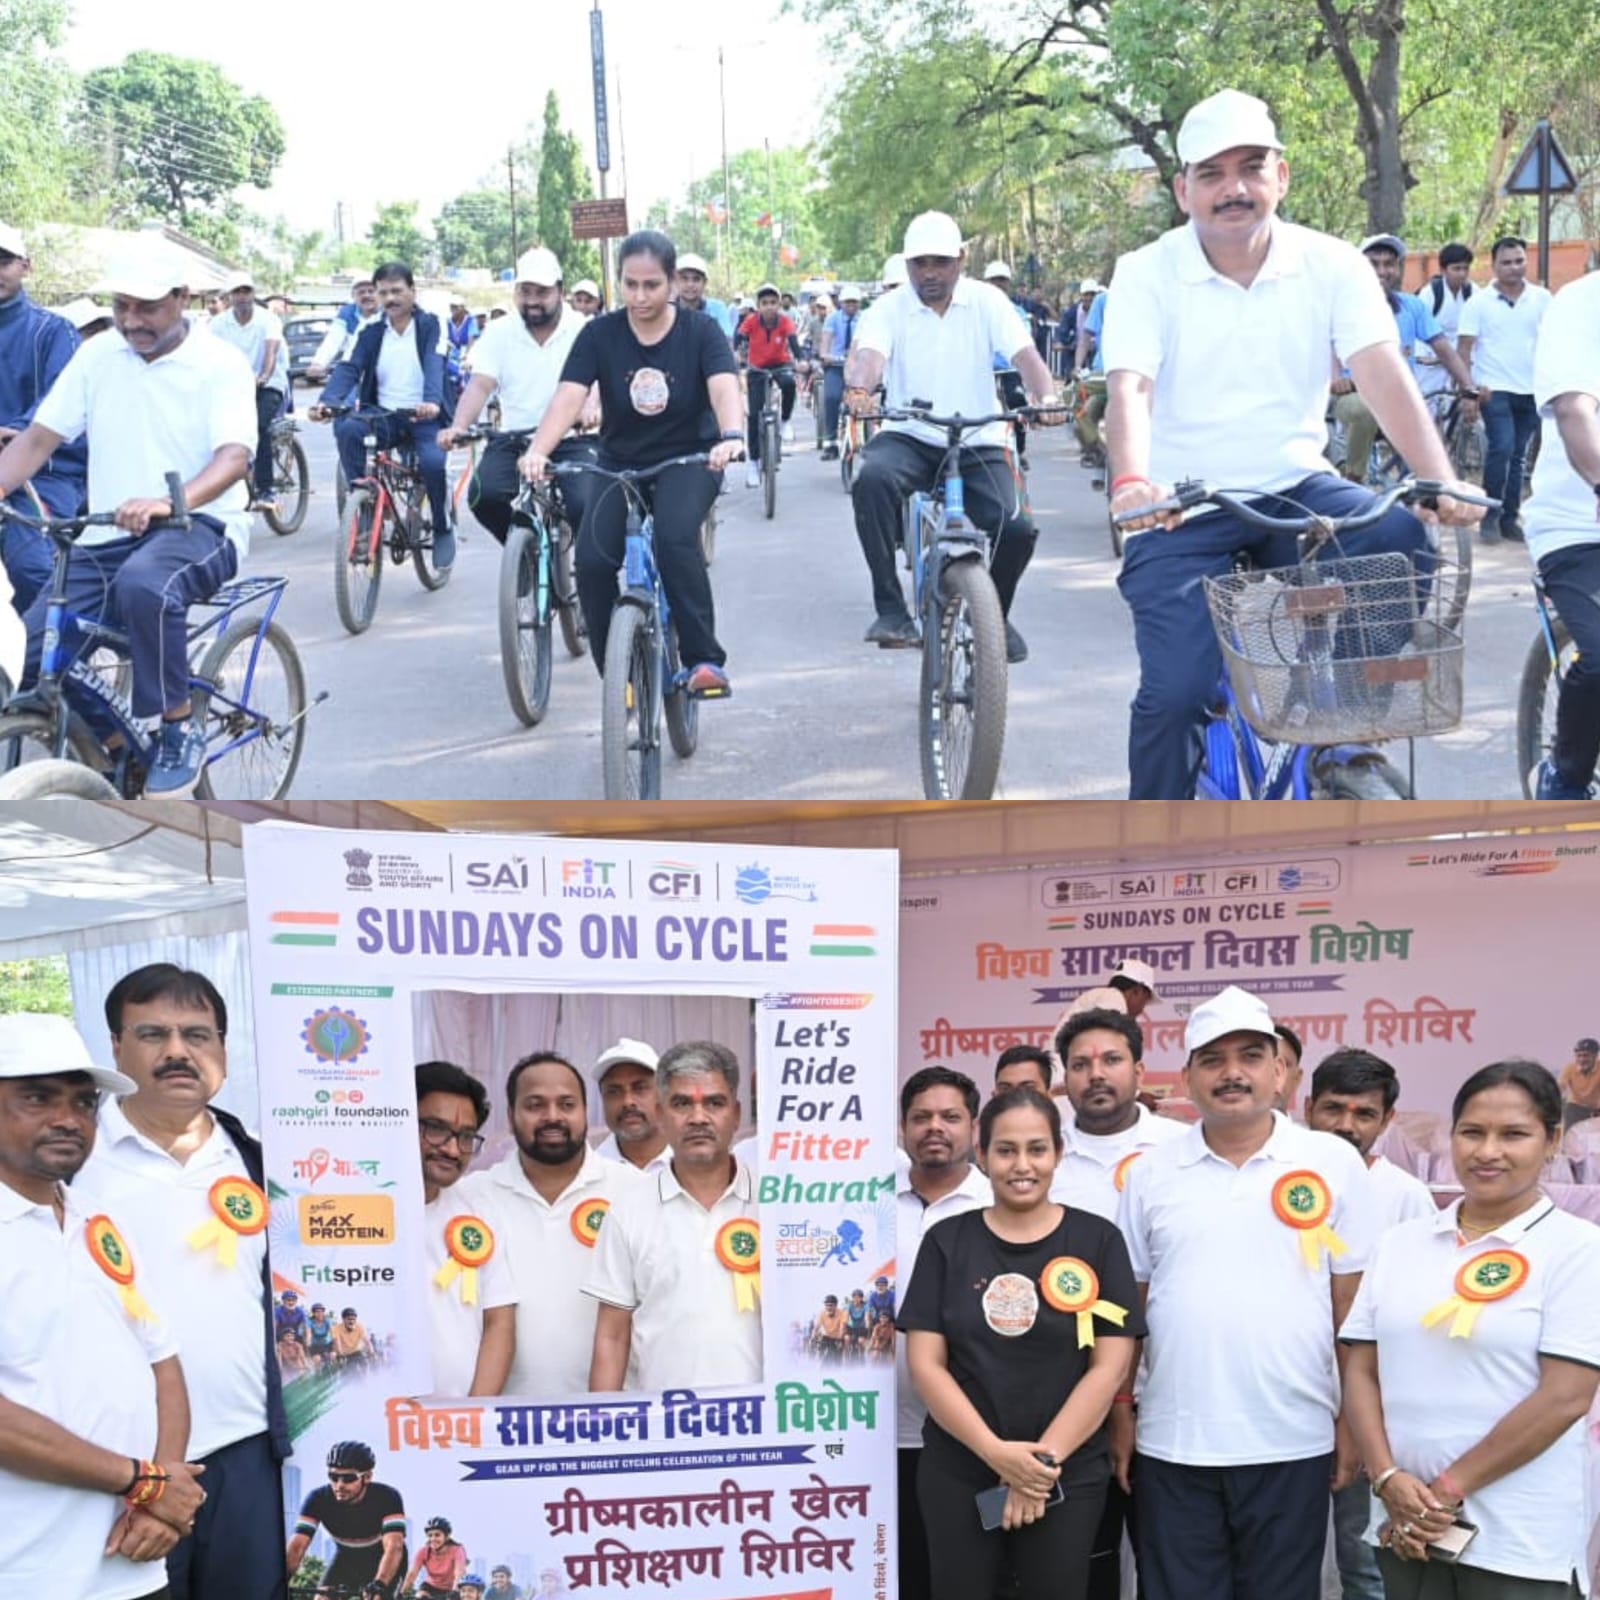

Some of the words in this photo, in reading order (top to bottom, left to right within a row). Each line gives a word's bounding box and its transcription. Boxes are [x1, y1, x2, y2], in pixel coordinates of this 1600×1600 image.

[1460, 852, 1485, 863] Ride
[1488, 851, 1509, 861] For
[1510, 850, 1518, 860] A
[1555, 846, 1597, 857] Bharat
[400, 881, 432, 889] SPORTS
[562, 885, 616, 899] INDIA
[648, 872, 701, 896] CFI
[1173, 888, 1205, 897] INDIA
[1224, 876, 1257, 890] CFI
[1083, 906, 1175, 930] SUNDAYS
[1183, 906, 1212, 925] ON
[1219, 902, 1286, 922] CYCLE
[357, 907, 563, 958] SUNDAYS
[580, 914, 638, 959] ON
[656, 915, 788, 962] CYCLE
[976, 943, 1053, 981] विश्व
[1061, 940, 1195, 976] सायकल
[1204, 930, 1300, 970] दिवस
[1310, 921, 1413, 965] विशेष
[775, 1019, 850, 1047] Let's
[1364, 996, 1476, 1047] शिविर
[781, 1056, 856, 1085] Ride
[272, 1105, 328, 1120] raahgiri
[335, 1106, 410, 1118] foundation
[777, 1094, 834, 1122] For
[839, 1094, 862, 1121] A
[769, 1130, 870, 1161] Fitter
[758, 1174, 880, 1204] Bharat
[309, 1213, 354, 1227] MAX
[310, 1227, 384, 1239] PROTEIN
[302, 1264, 394, 1286] Fitspire
[385, 1396, 484, 1451] विश्व
[495, 1400, 652, 1446] सायकल
[661, 1388, 765, 1439] दिवस
[775, 1379, 879, 1434] विशेष
[825, 1438, 844, 1459] एवं
[495, 1463, 520, 1474] GEAR
[523, 1463, 536, 1473] UP
[539, 1462, 558, 1473] FOR
[560, 1460, 578, 1471] THE
[581, 1459, 619, 1470] BIGGEST
[621, 1457, 661, 1468] CYCLING
[663, 1454, 724, 1466] CELEBRATION
[726, 1453, 738, 1463] OF
[741, 1452, 758, 1462] THE
[760, 1451, 783, 1461] YEAR
[544, 1478, 774, 1537] ग्रीष्मकालीन
[789, 1473, 871, 1522] खेल
[564, 1538, 724, 1590] प्रशिक्षण
[740, 1526, 856, 1579] शिविर
